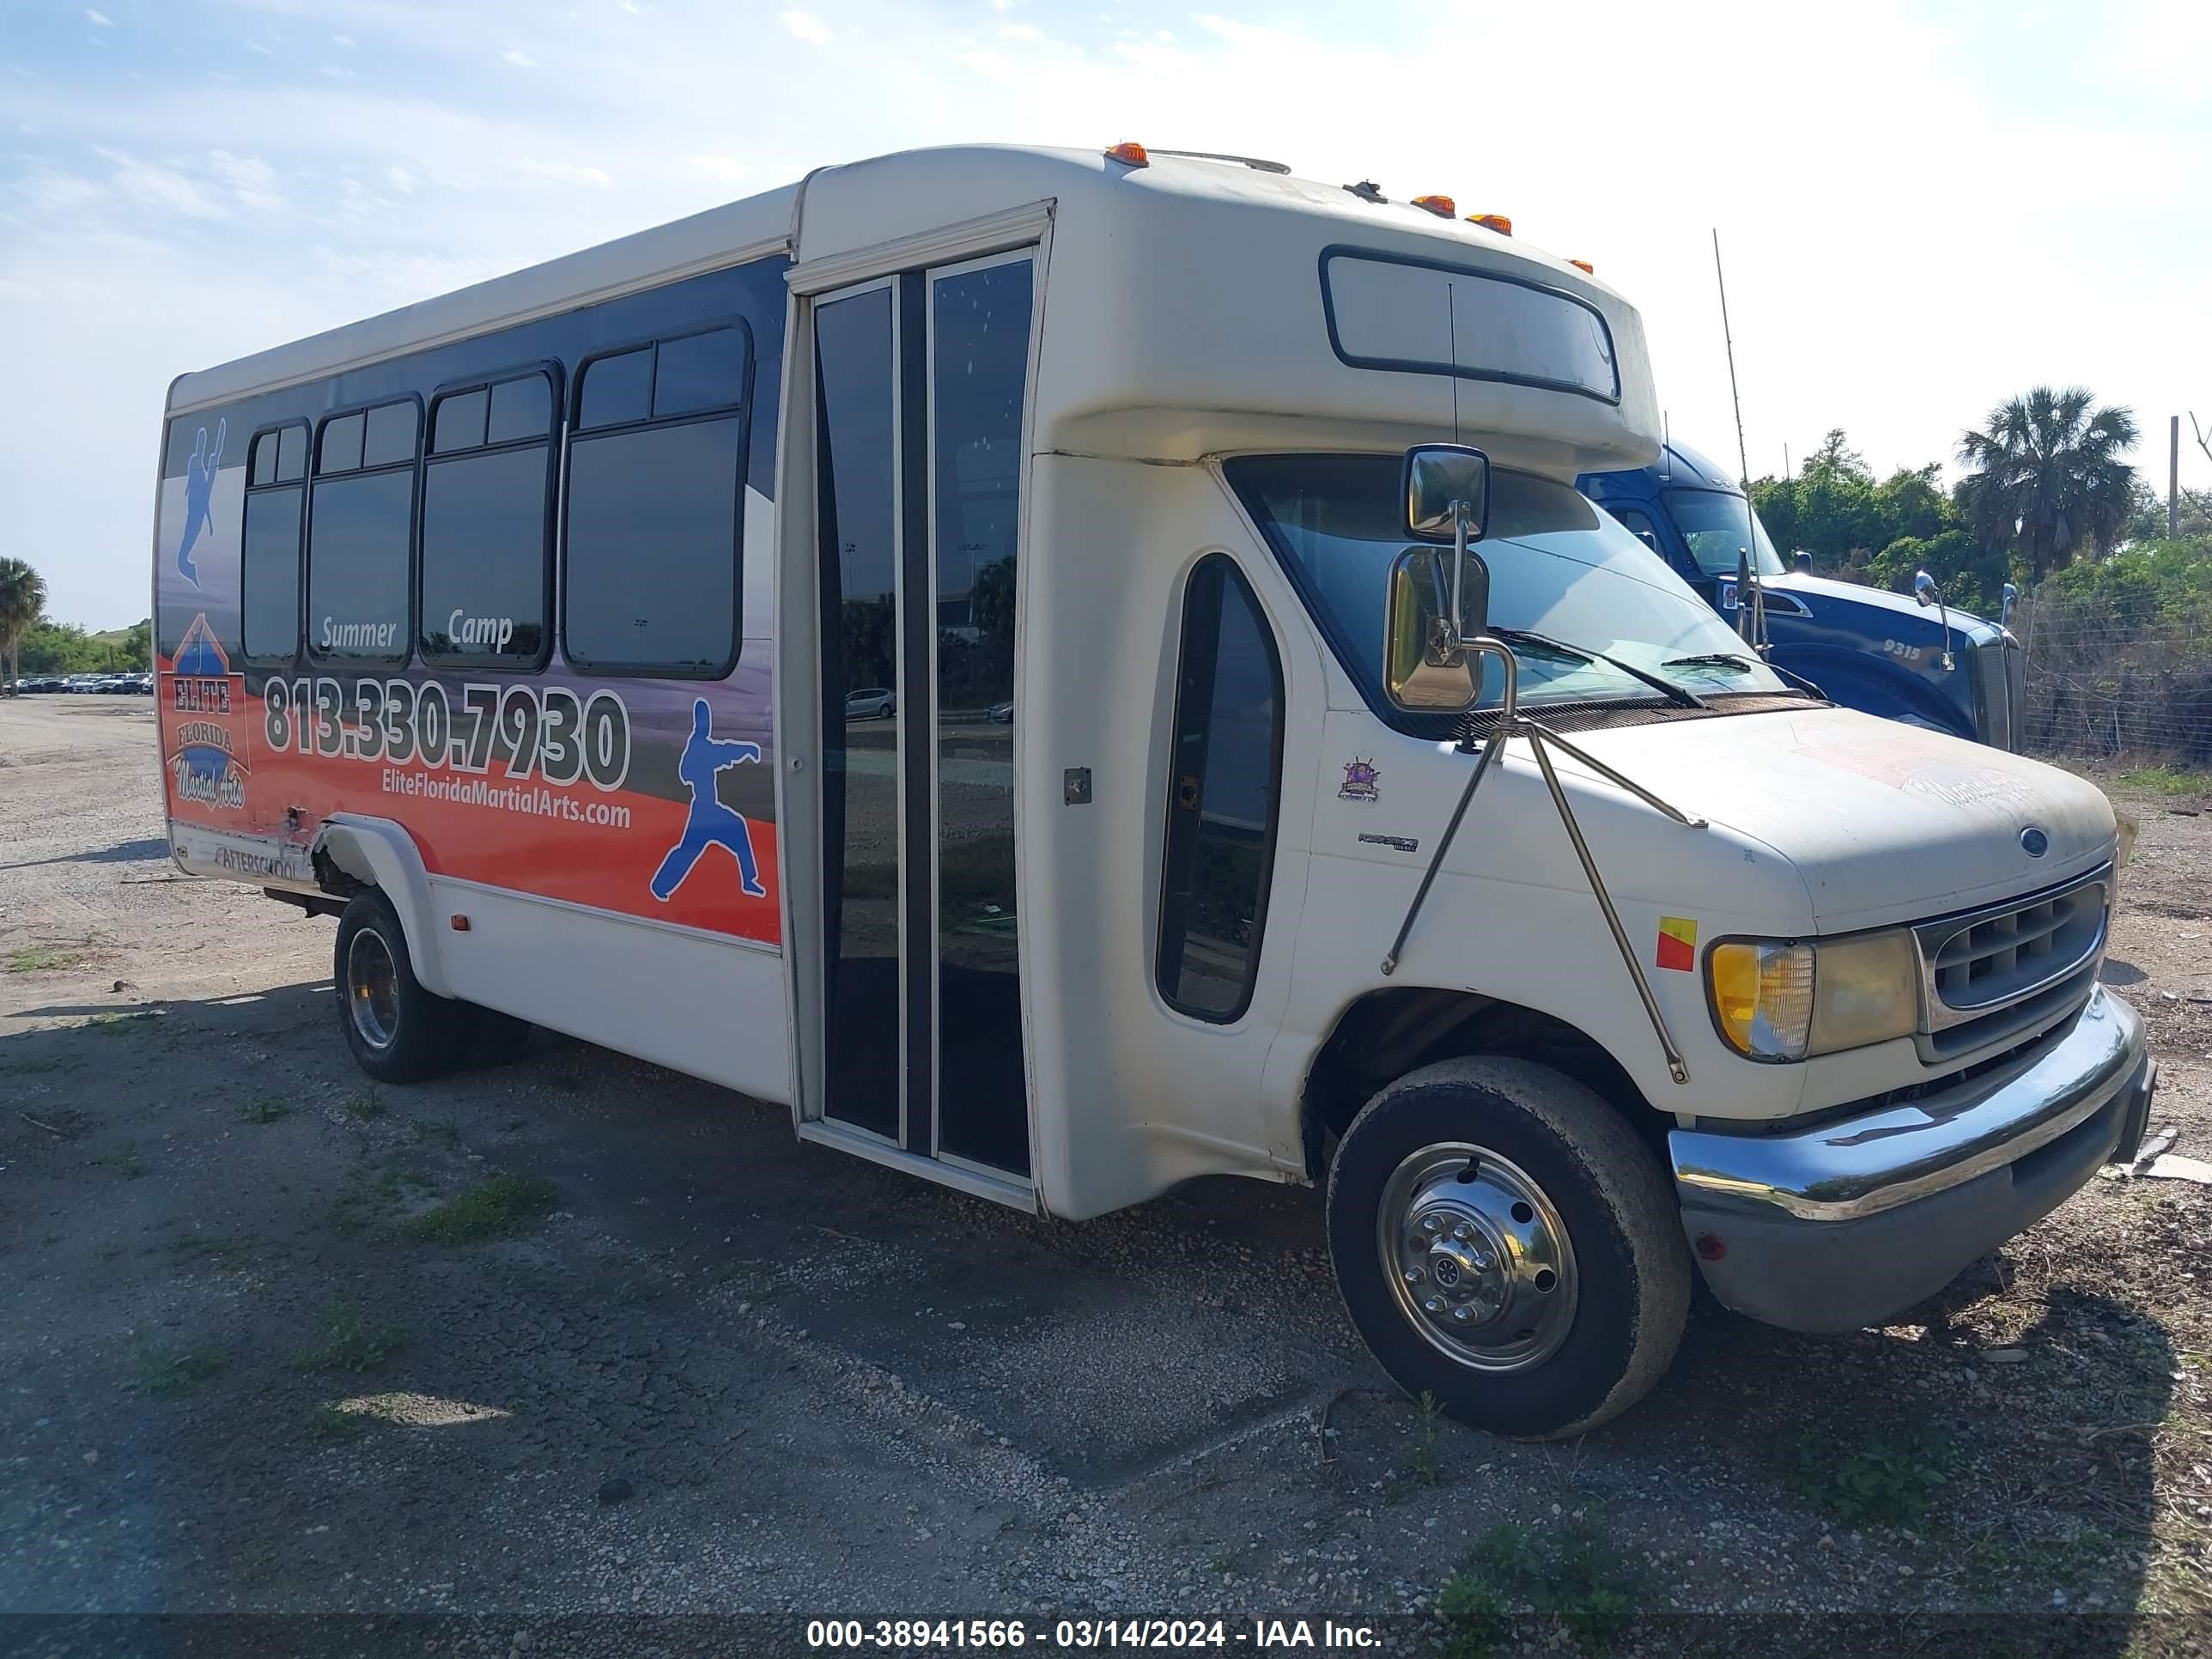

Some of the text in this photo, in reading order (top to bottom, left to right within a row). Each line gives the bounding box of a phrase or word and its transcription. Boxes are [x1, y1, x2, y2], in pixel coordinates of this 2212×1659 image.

[321, 610, 513, 653] Summer Camp
[1884, 639, 1922, 659] 9315
[173, 679, 231, 714] ELITE
[177, 722, 234, 757] FLORIDA
[264, 676, 631, 792] 813.330.7930
[175, 757, 244, 809] Martial Arts
[382, 769, 630, 828] EliteFloridaMartialArts.com
